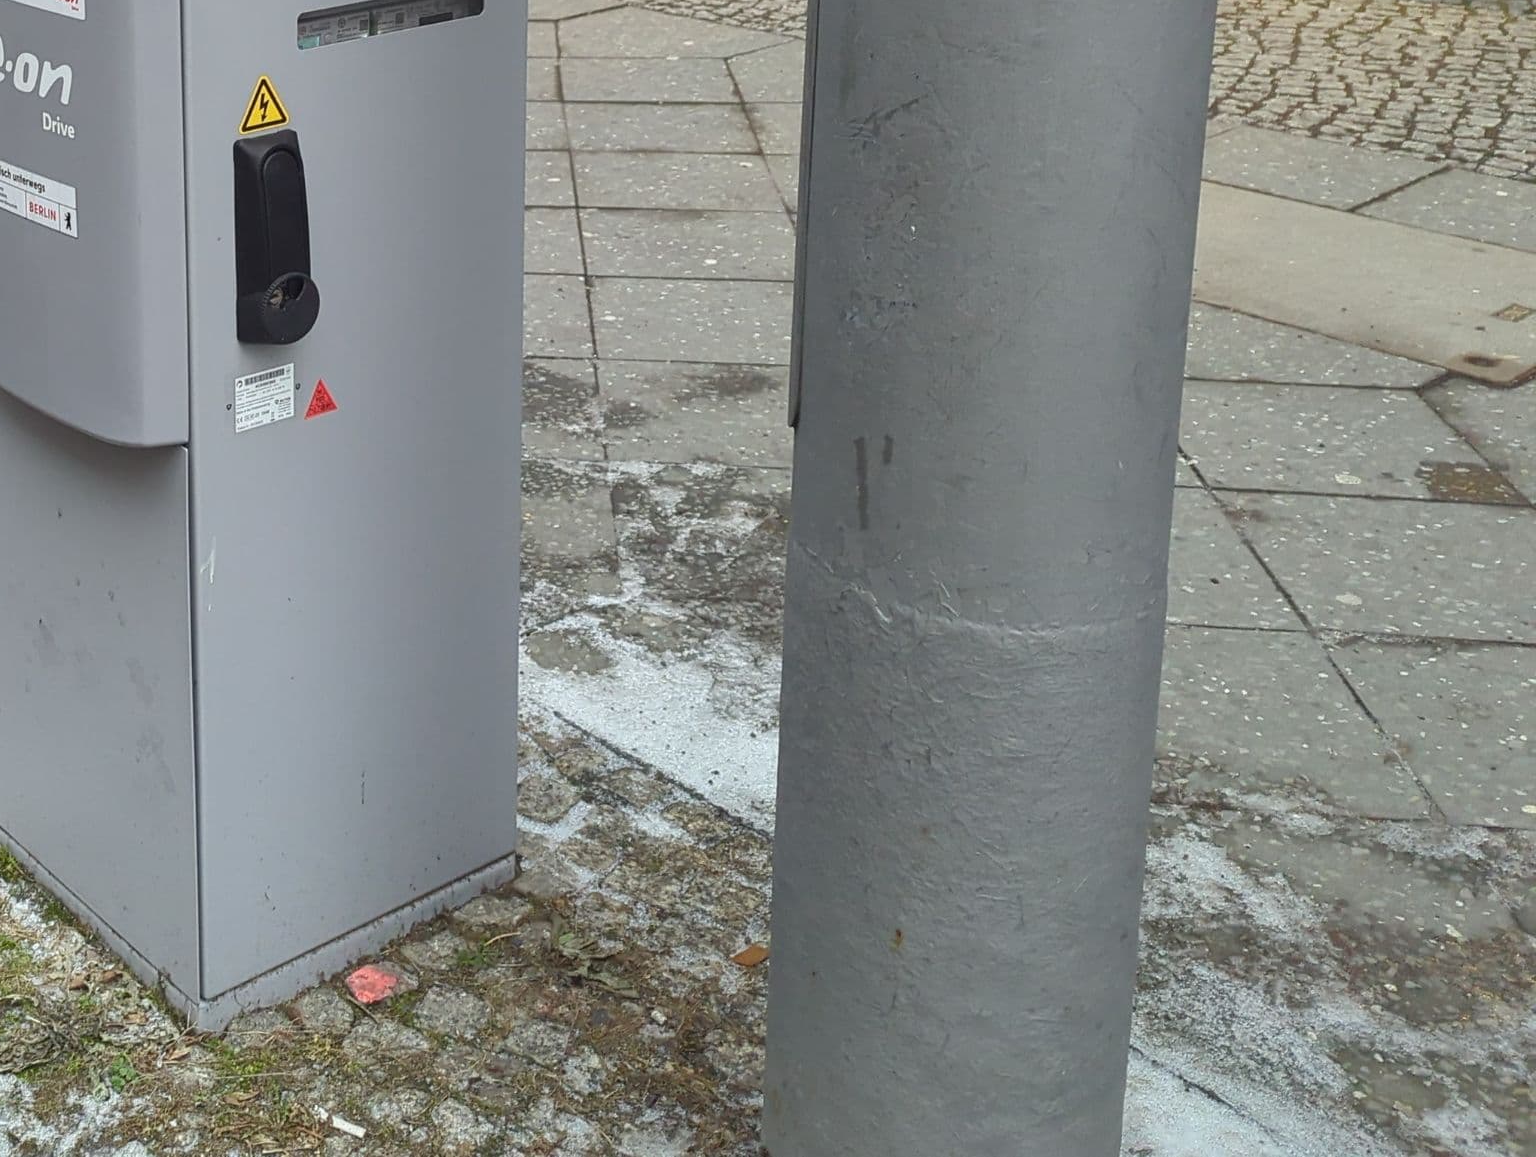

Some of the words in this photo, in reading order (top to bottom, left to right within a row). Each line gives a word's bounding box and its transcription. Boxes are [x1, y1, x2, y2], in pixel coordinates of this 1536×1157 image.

[42, 112, 76, 139] Drive
[12, 173, 46, 194] unterwegs
[29, 201, 57, 222] BERLIN
